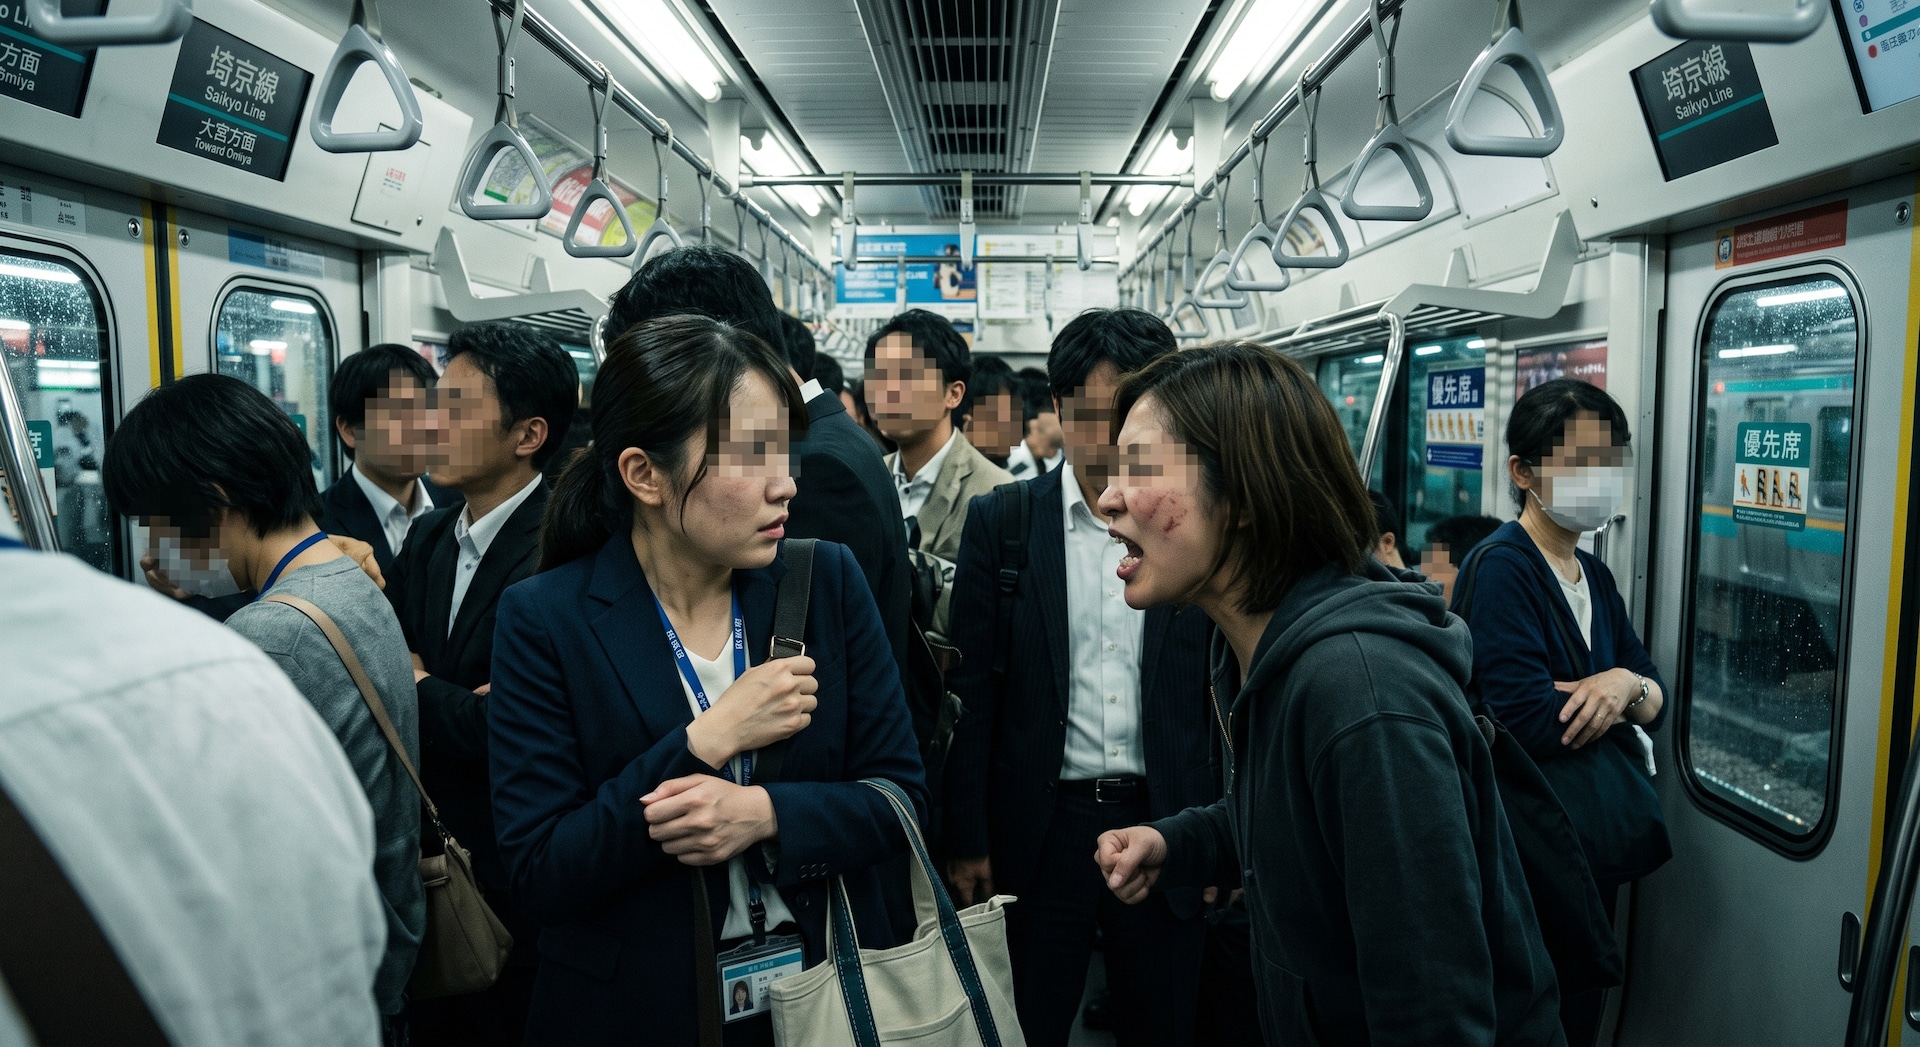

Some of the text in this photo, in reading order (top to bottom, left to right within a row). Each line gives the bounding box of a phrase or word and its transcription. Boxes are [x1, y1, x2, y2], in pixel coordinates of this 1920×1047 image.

[206, 45, 280, 104] 埼京線
[1661, 44, 1731, 101] 埼京線
[204, 85, 267, 121] Saikyo Line
[1675, 86, 1734, 120] Saikyo Line
[194, 136, 226, 157] Toward
[198, 117, 258, 153] 大宮方面
[1431, 374, 1472, 406] 優先席
[1743, 429, 1802, 461] 優先席
